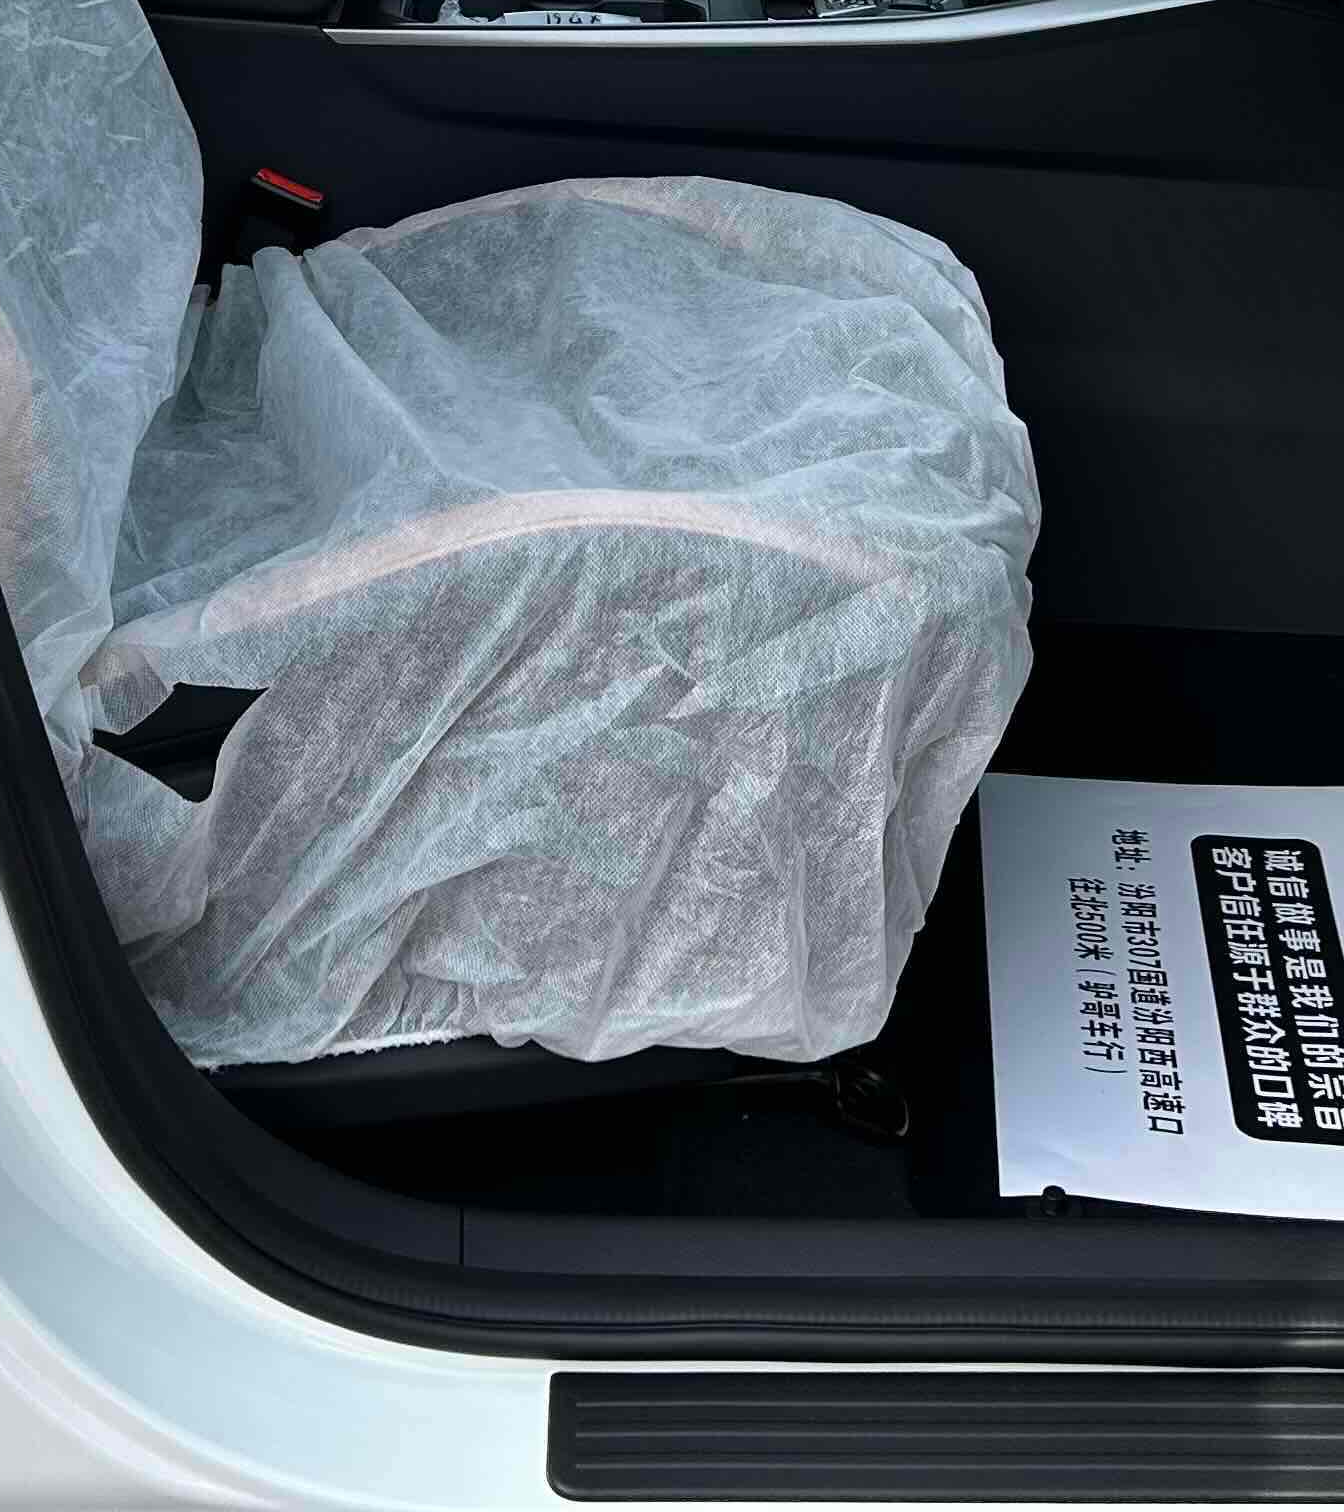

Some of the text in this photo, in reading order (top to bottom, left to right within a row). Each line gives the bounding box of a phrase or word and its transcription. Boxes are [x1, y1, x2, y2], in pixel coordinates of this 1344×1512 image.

[1212, 846, 1304, 1128] 客户信任源于群众的口碑
